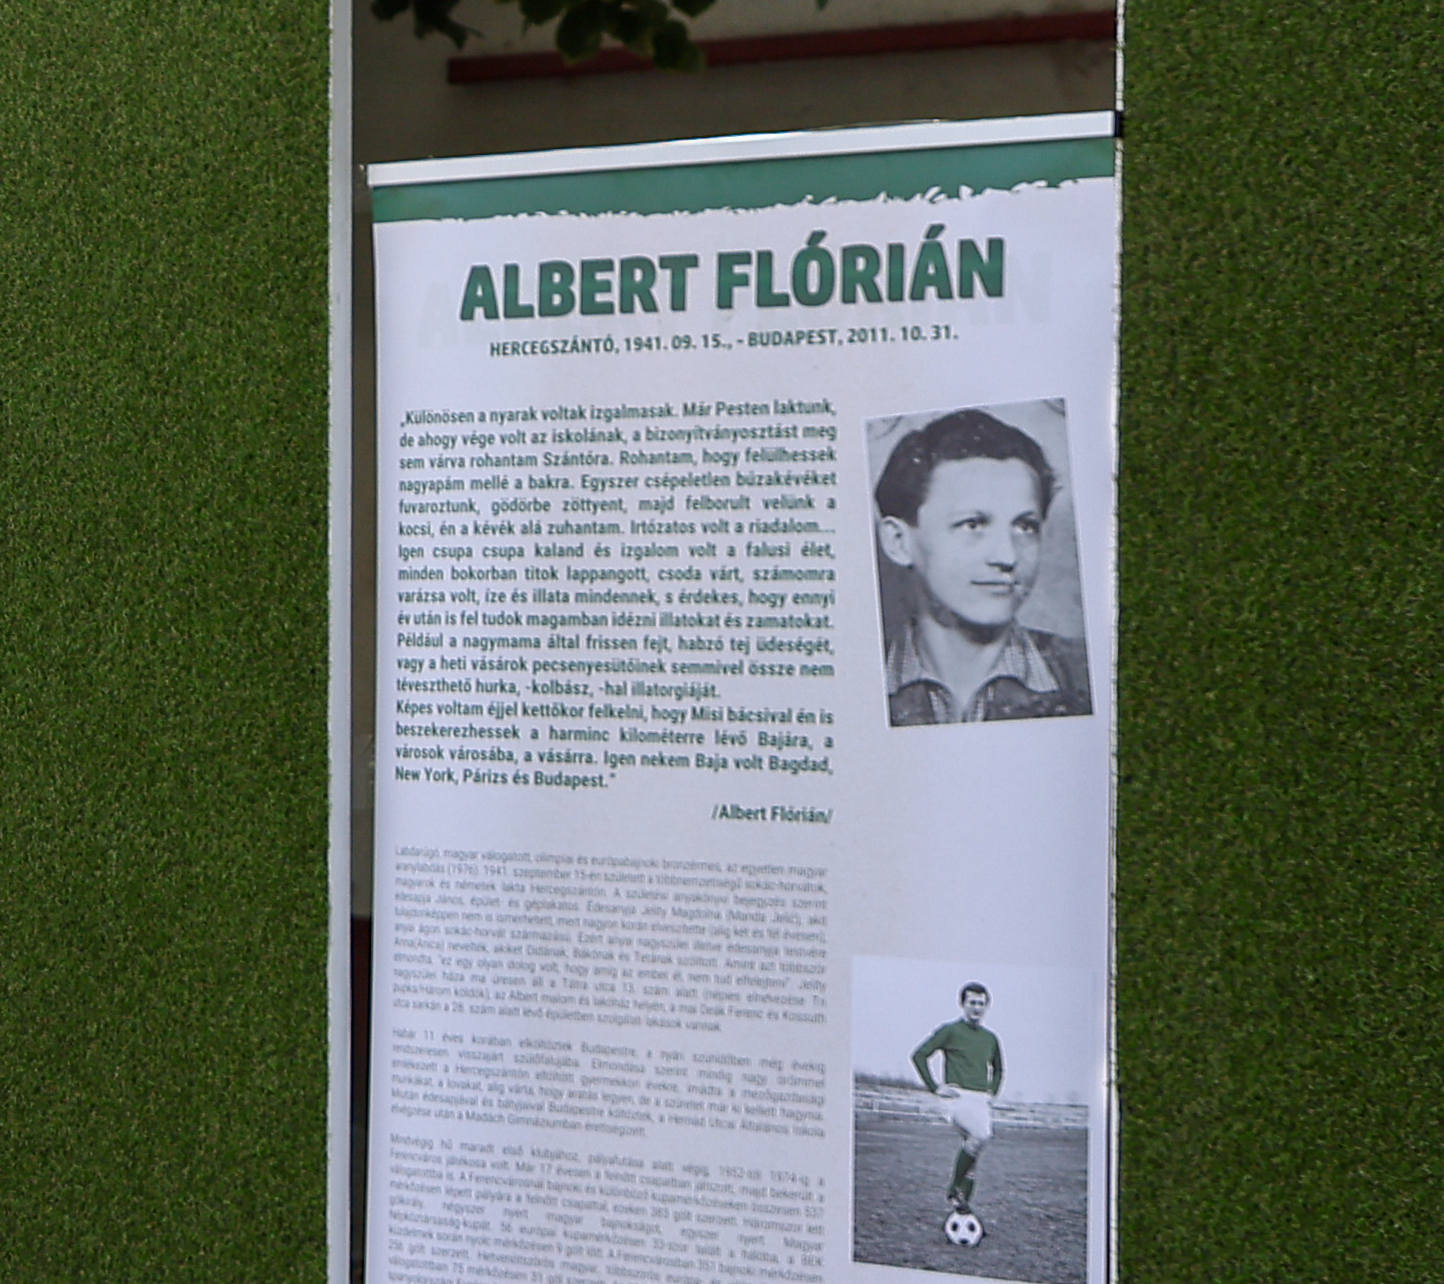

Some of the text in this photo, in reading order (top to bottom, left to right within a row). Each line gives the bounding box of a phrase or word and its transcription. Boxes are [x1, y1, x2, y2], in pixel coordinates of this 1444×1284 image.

[461, 224, 1005, 321] ALBERT FLÓRIÁN
[490, 334, 620, 357] HERCEGSZÁNTÓ,
[624, 332, 668, 352] 1941.
[671, 332, 697, 350] 09.
[748, 326, 844, 349] BUDAPEST,
[846, 325, 895, 344] 2011.
[901, 324, 927, 342] 10.
[931, 323, 959, 341] 31.
[477, 411, 486, 423] a
[489, 406, 538, 427] nyarak
[540, 405, 586, 422] voltak
[590, 402, 678, 425] izgalmasak.
[682, 401, 712, 418] Már
[715, 400, 770, 418] Pesten
[773, 398, 836, 421] laktunk,
[399, 431, 414, 447] de
[417, 430, 457, 451] ahogy
[460, 430, 495, 450] vége
[498, 429, 526, 445] volt
[530, 432, 547, 445] az
[551, 427, 627, 449] iskolának,
[632, 430, 641, 443] a
[802, 426, 837, 444] meg
[399, 458, 424, 470] sem
[428, 453, 465, 469] várva
[469, 451, 538, 468] rohantam
[542, 450, 614, 467] Szántóra.
[619, 448, 697, 470] Rohantam,
[701, 448, 740, 469] hogy
[398, 475, 464, 496] nagyapám
[469, 475, 509, 491] mellé
[513, 478, 522, 490] a
[528, 474, 574, 490] bakra.
[580, 473, 639, 494] Egyszer
[644, 471, 730, 493] csépeletlen
[398, 498, 480, 519] fuvaroztunk,
[490, 497, 551, 518] gödörbe
[561, 496, 627, 517] zöttyent,
[638, 495, 674, 516] majd
[685, 495, 750, 512] felborult
[826, 498, 836, 510] a
[398, 541, 835, 563] Igen csupa csupa kaland és izgalom volt a falusi élet,
[398, 566, 443, 581] minden
[450, 566, 517, 581] bokorban
[566, 565, 650, 586] lappangott,
[657, 565, 702, 582] csoda
[709, 565, 744, 586] várt,
[397, 588, 445, 604] varázsa
[449, 588, 480, 608] volt,
[510, 588, 528, 604] és
[532, 588, 569, 604] illata
[574, 589, 660, 609] mindennek,
[664, 593, 673, 605] s
[677, 589, 743, 610] érdekes,
[747, 589, 787, 610] hogy
[791, 589, 835, 610] ennyi
[396, 633, 443, 649] Például
[448, 637, 457, 649] a
[462, 637, 540, 654] nagymama
[546, 634, 580, 651] által
[585, 635, 637, 651] frissen
[643, 635, 672, 656] fejt,
[677, 635, 724, 652] habzó
[729, 636, 750, 657] tej
[396, 678, 471, 695] téveszthető
[475, 679, 521, 700] hurka,
[525, 680, 594, 701] -kolbász,
[598, 681, 627, 697] -hal
[396, 700, 433, 721] Képes
[436, 701, 483, 718] voltam
[521, 703, 585, 720] kettőkor
[588, 704, 648, 726] felkelni,
[650, 705, 687, 726] hogy
[727, 706, 792, 724] bácsival
[795, 708, 816, 725] én
[819, 708, 833, 725] is
[395, 723, 834, 753] beszekerezhessek a harminc kilométerre lévő Bajára, a
[395, 745, 833, 777] városok városába, a vásárra. Igen nekem Baja volt Bagdad,
[395, 767, 420, 784] New
[424, 768, 458, 789] York,
[462, 769, 508, 787] Párizs
[511, 771, 529, 787] és
[711, 804, 833, 823] /Albert Flórián/
